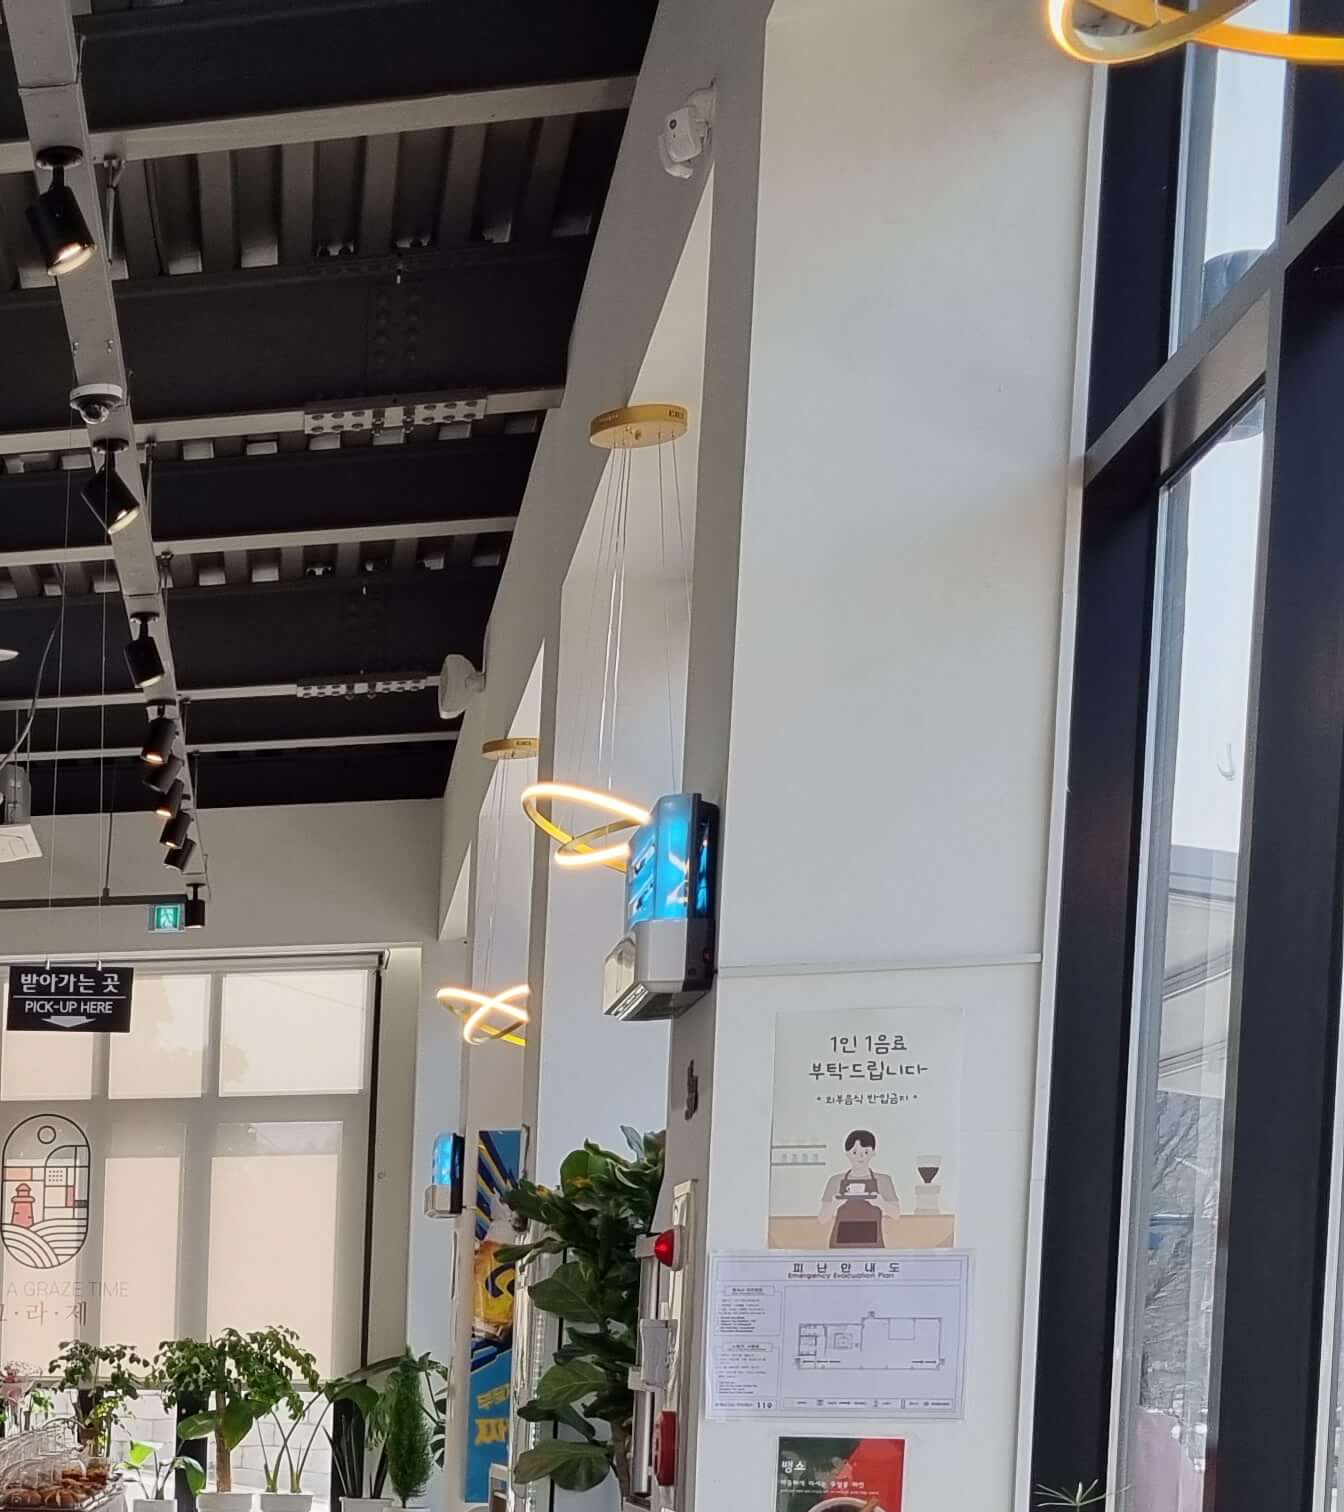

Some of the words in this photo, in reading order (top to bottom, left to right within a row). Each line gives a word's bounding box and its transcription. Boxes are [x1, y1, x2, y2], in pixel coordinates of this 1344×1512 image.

[20, 973, 96, 993] 받아가는
[102, 973, 120, 993] 곳
[25, 1000, 78, 1013] PICK-UP
[80, 1001, 113, 1014] HERE
[830, 1035, 857, 1053] 1인
[865, 1034, 907, 1055] 1음료
[809, 1060, 928, 1081] 부탁드립니다
[23, 1281, 81, 1297] GRAZE
[88, 1281, 129, 1297] TIME
